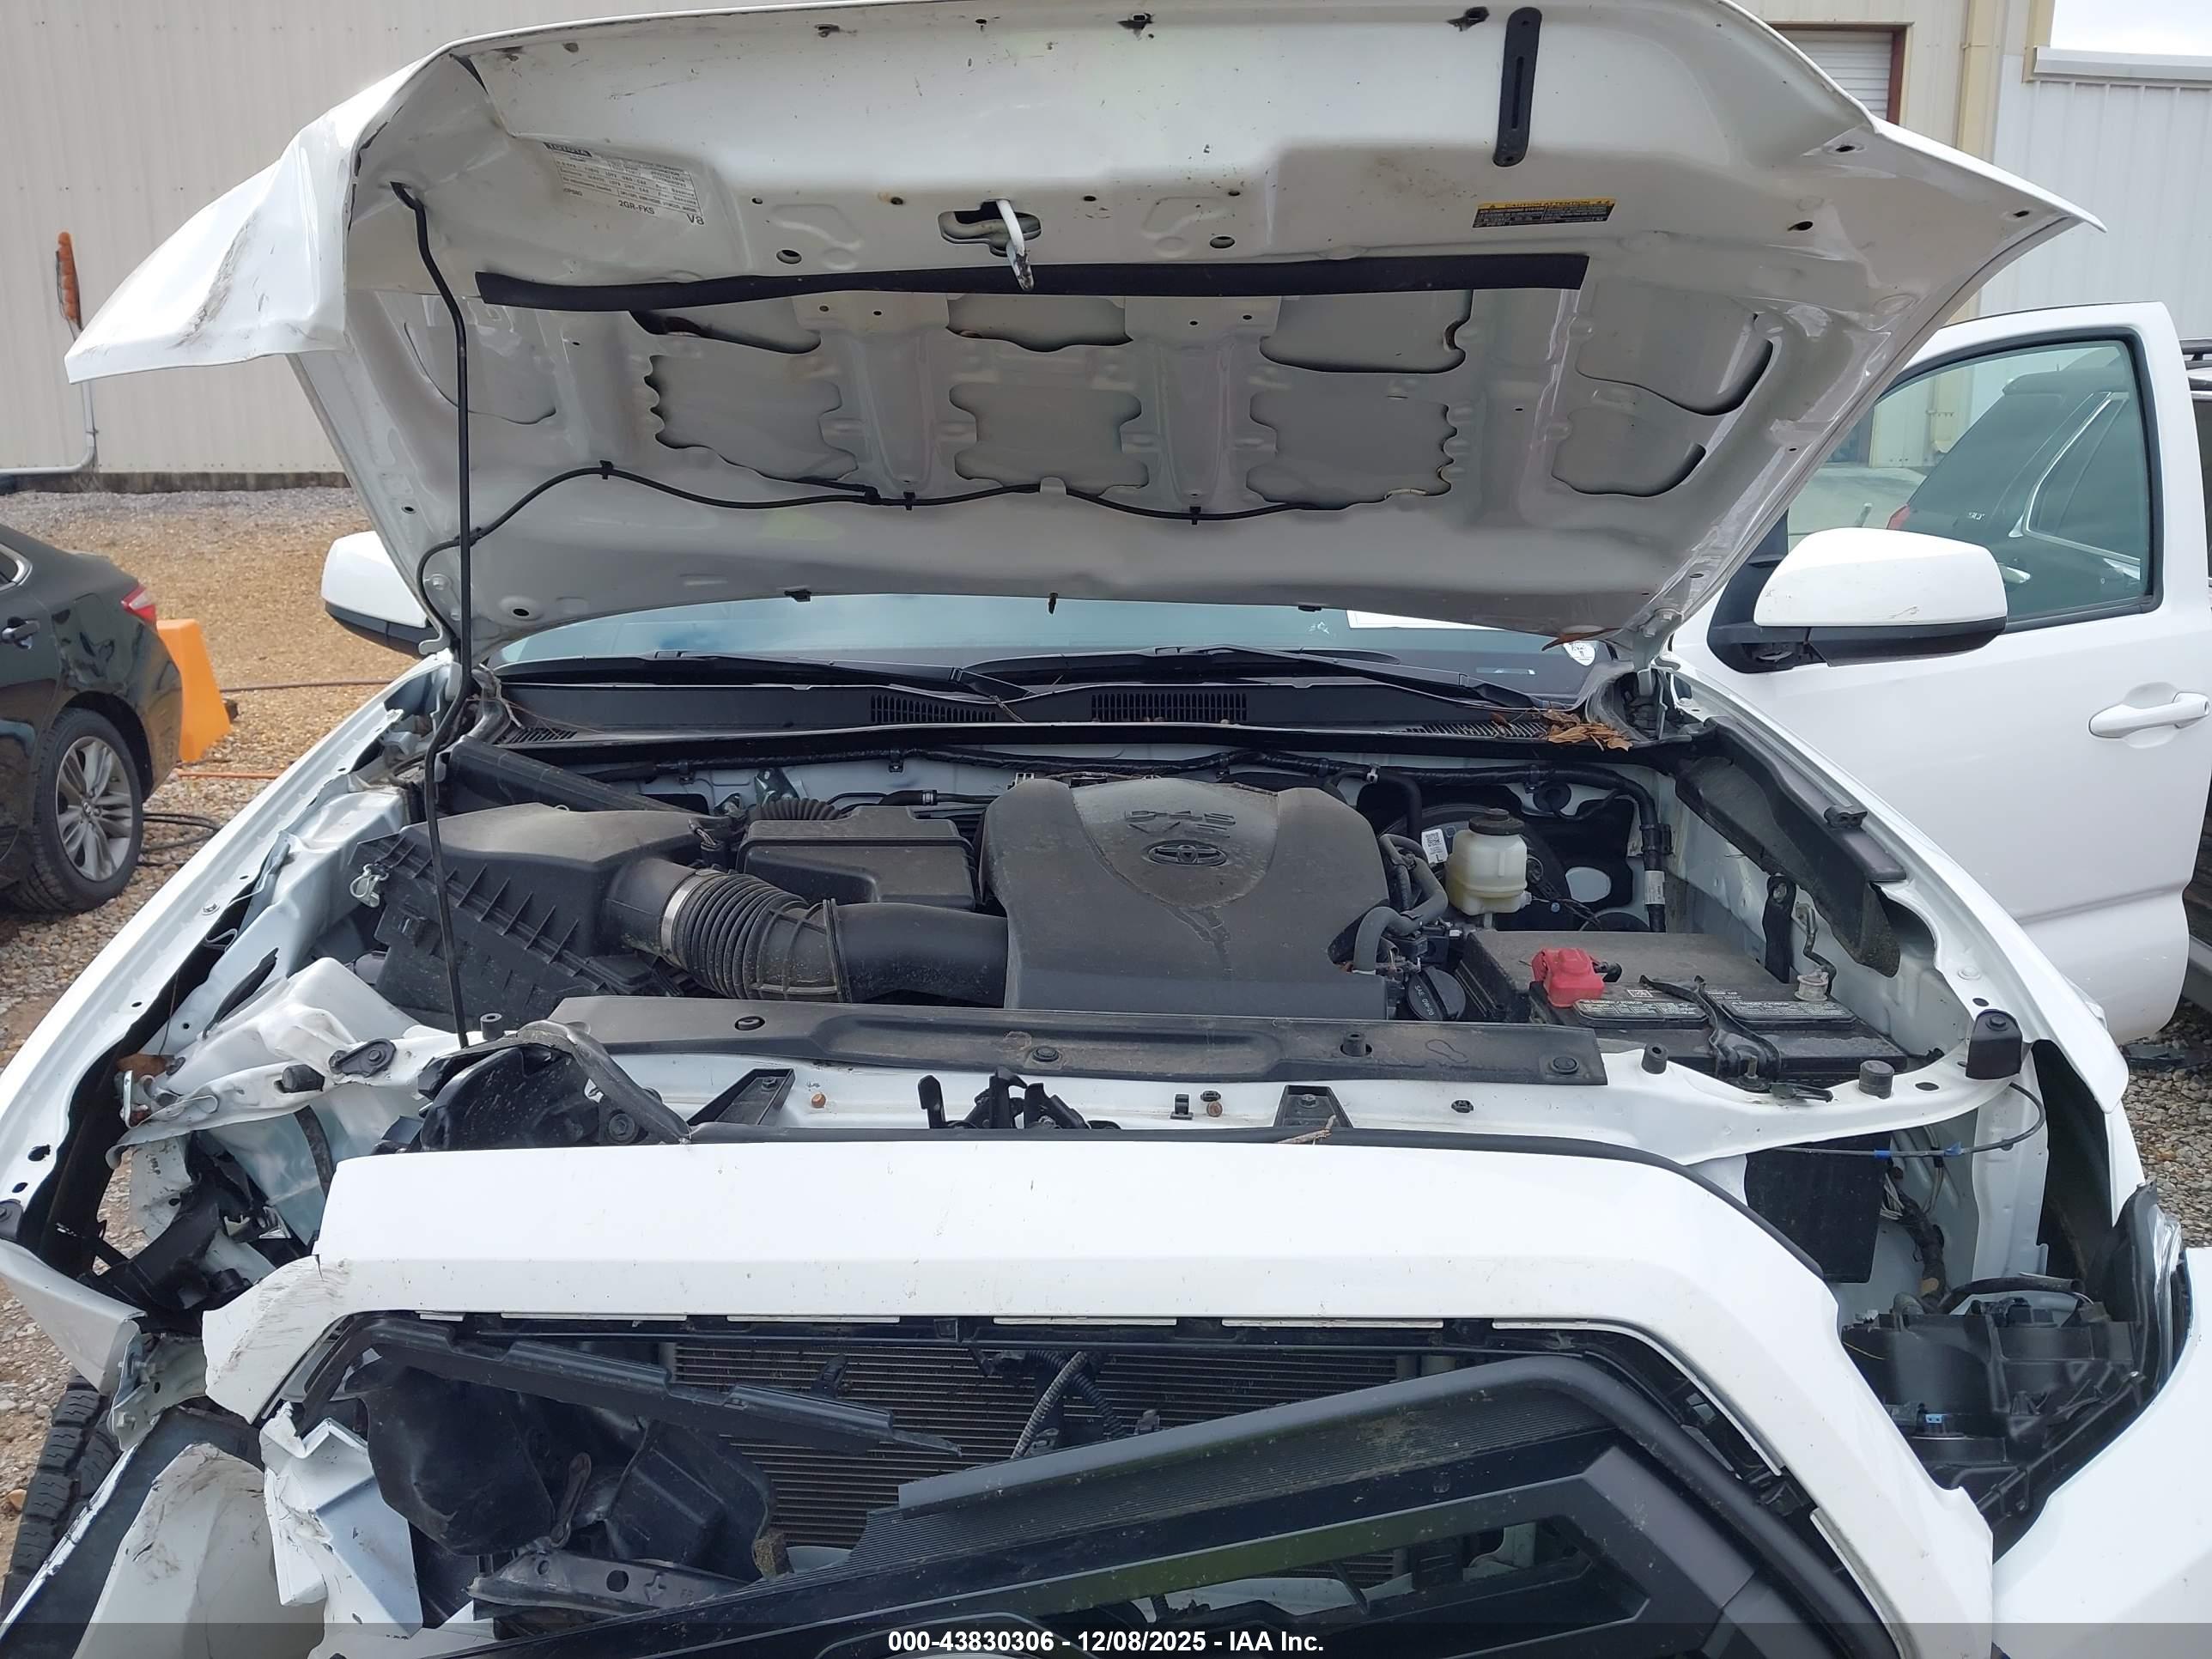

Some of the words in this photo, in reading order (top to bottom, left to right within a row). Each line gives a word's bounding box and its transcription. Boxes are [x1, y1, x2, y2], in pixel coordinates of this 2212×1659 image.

[618, 199, 655, 215] 2GR-FKS
[1414, 985, 1425, 997] SAE
[1422, 998, 1435, 1016] 0W-20
